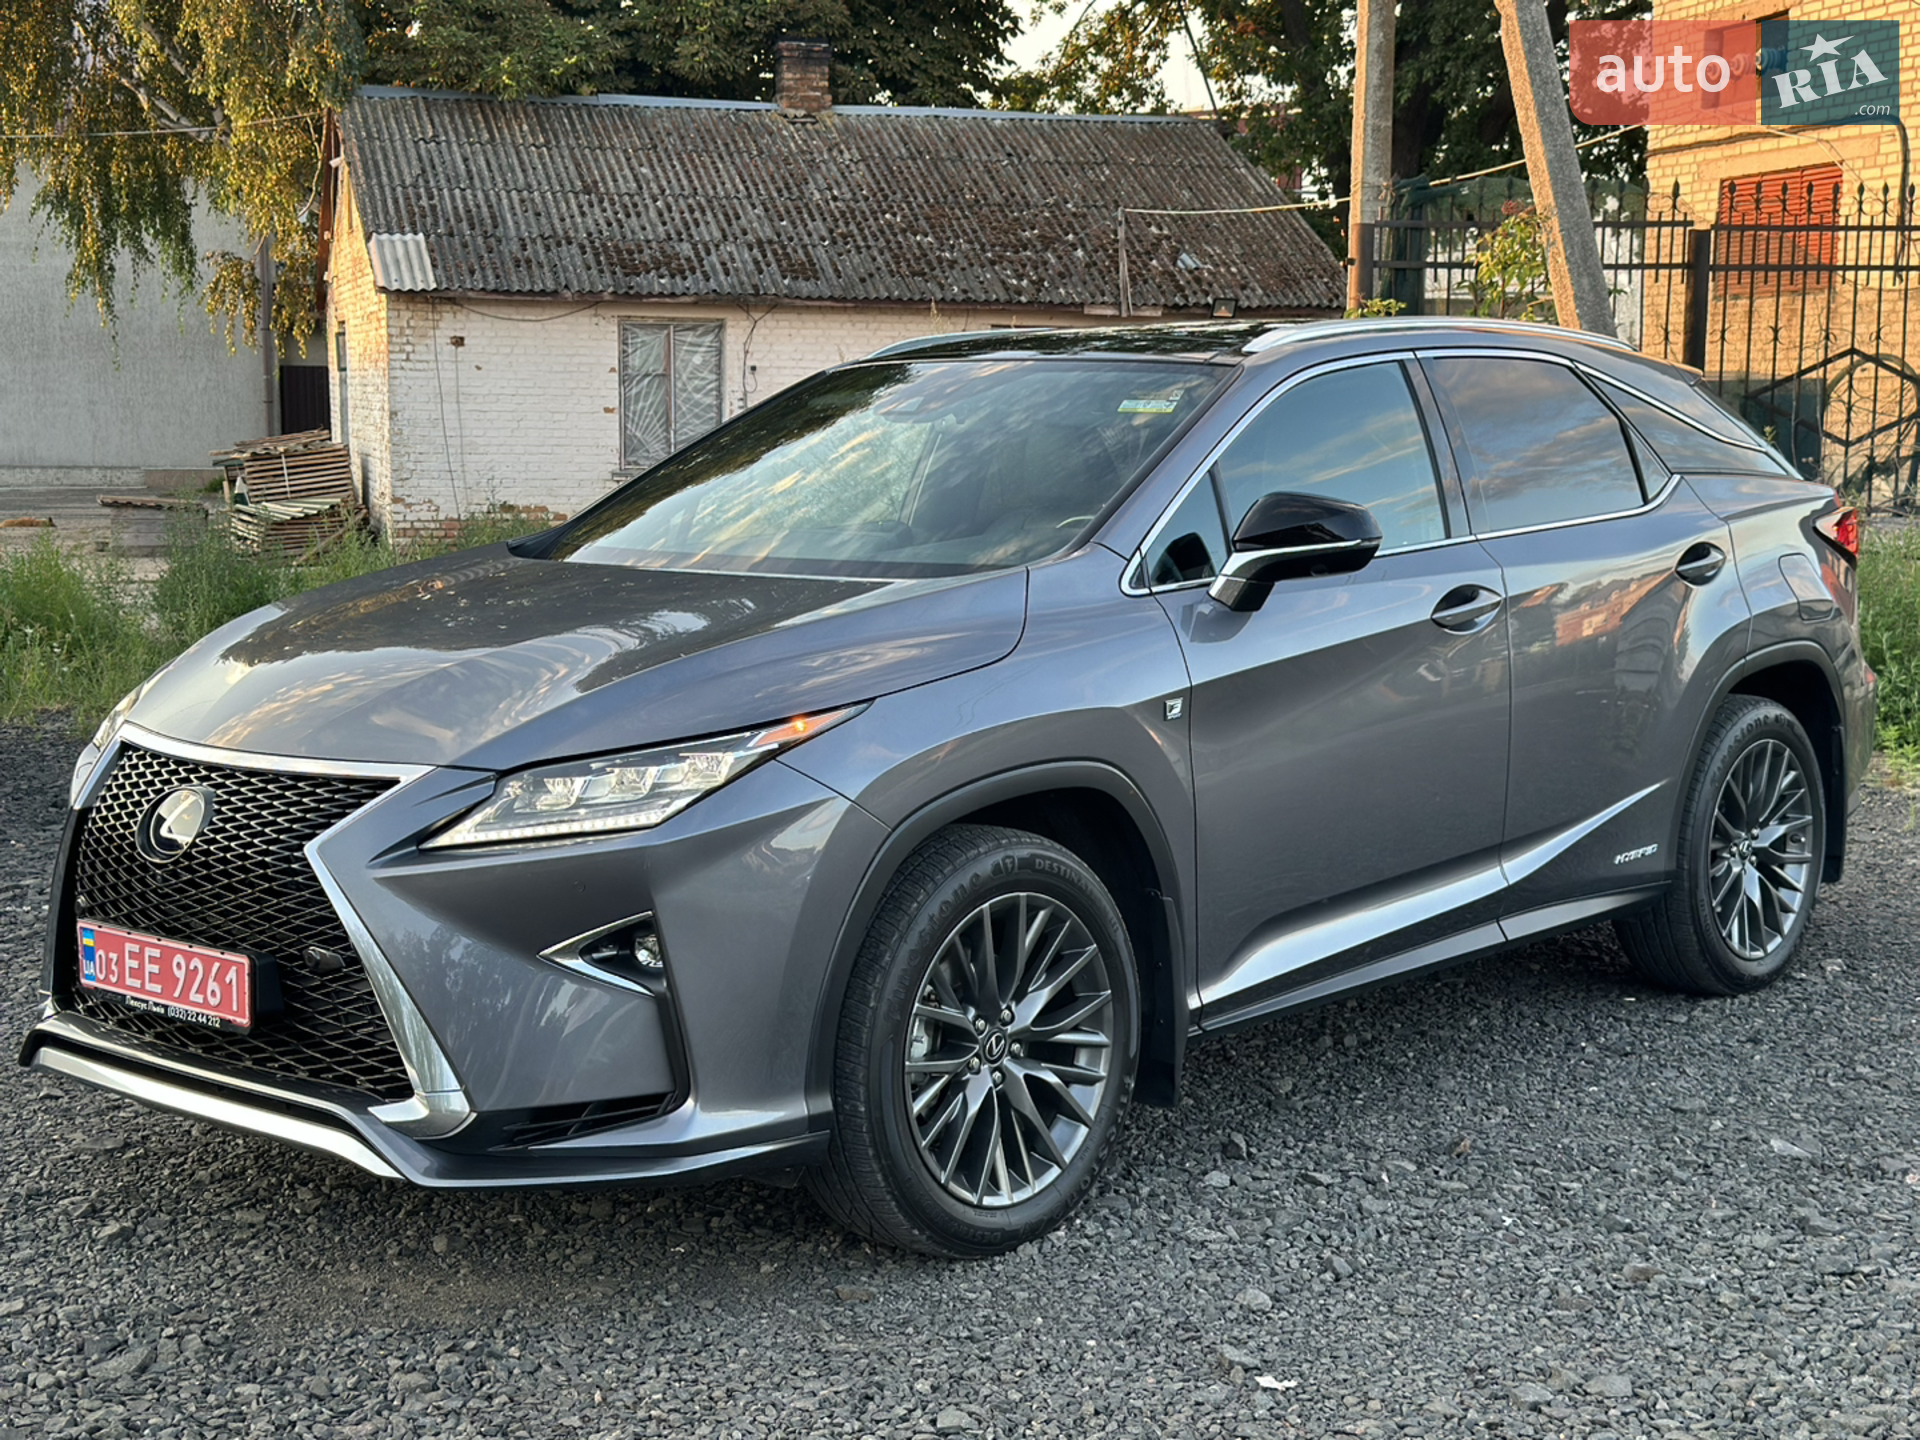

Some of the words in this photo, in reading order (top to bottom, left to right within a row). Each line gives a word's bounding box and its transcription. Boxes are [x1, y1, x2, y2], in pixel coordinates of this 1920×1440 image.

[83, 960, 95, 976] UA
[96, 949, 118, 984] 03
[125, 942, 162, 993] EE
[172, 954, 239, 1012] 9261
[167, 1007, 187, 1021] (032)
[187, 1010, 198, 1023] 22
[198, 1013, 208, 1025] 44
[208, 1015, 221, 1028] 212
